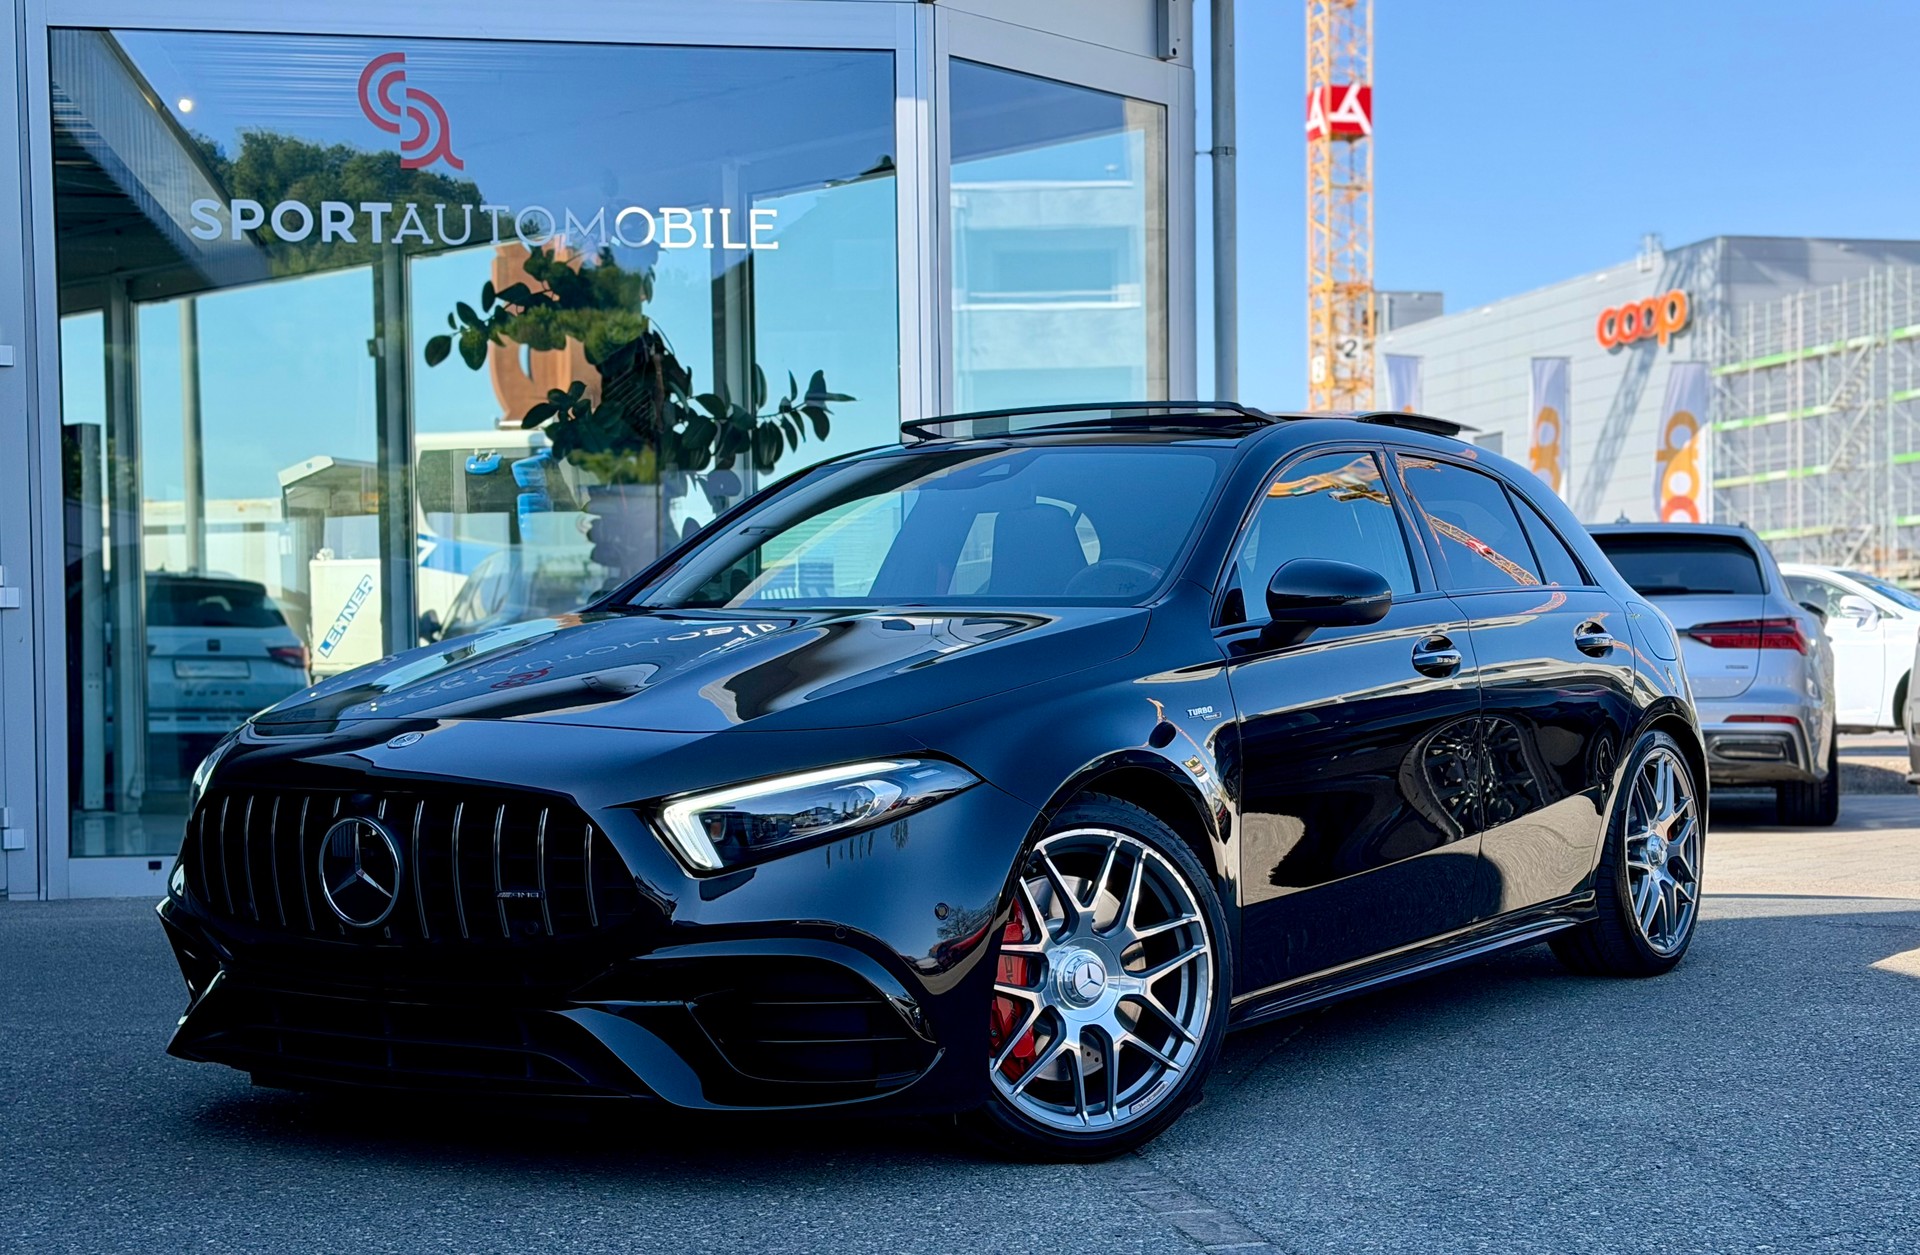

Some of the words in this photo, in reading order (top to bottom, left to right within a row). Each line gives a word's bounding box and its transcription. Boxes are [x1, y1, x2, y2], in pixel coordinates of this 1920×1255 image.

[190, 199, 778, 249] SPORTAUTOMOBILE
[1596, 289, 1688, 349] coop
[1187, 705, 1213, 717] TURBO
